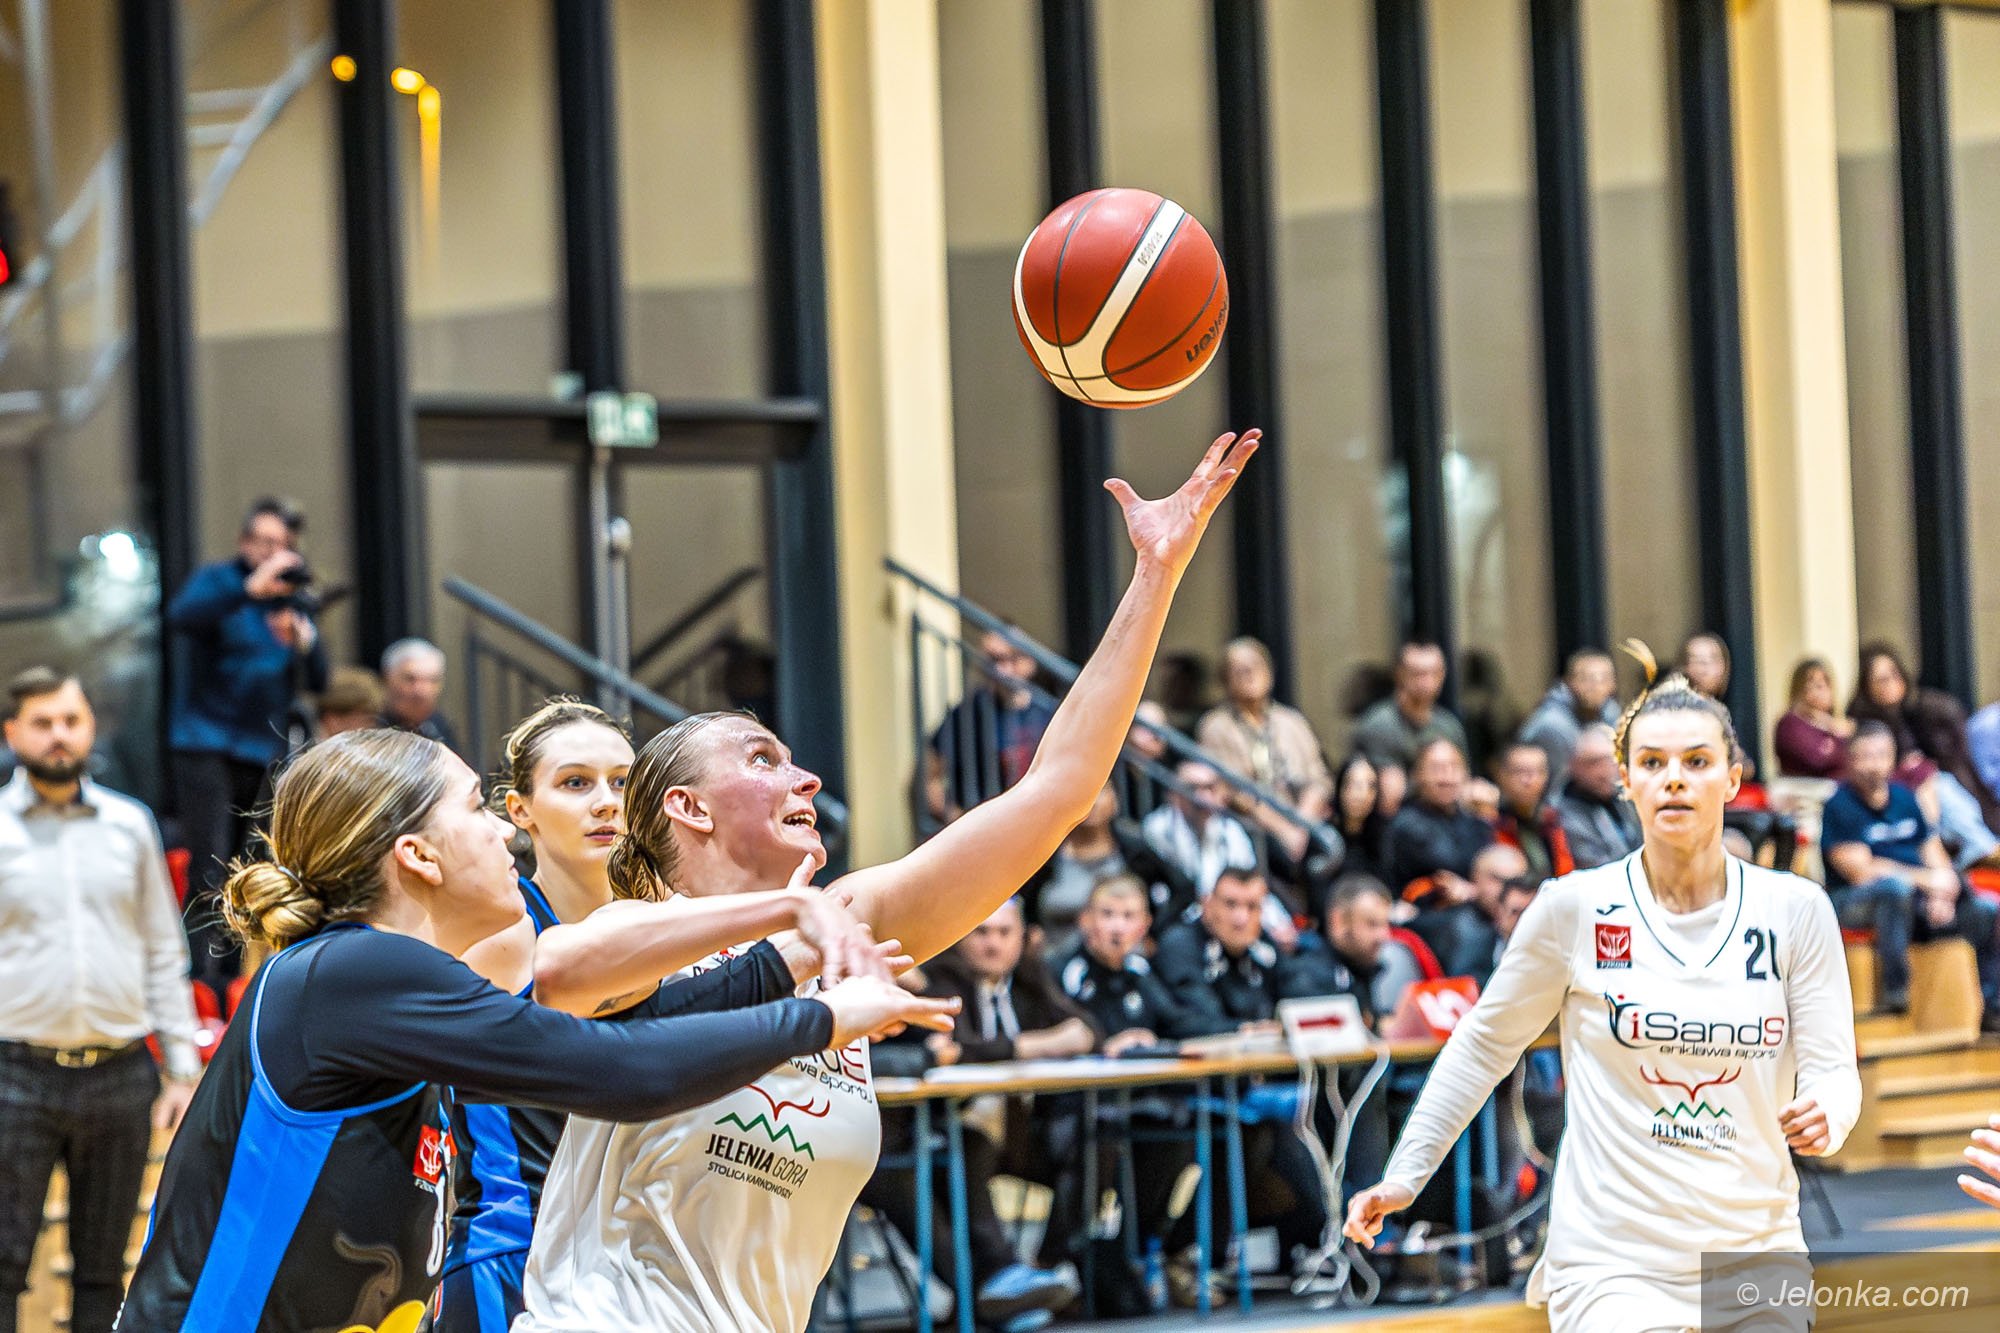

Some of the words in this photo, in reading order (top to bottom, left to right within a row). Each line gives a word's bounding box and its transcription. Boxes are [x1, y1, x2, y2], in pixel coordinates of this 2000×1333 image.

[1744, 926, 1781, 981] 21
[705, 1133, 775, 1173] JELENIA
[772, 1156, 809, 1188] GÓRA
[708, 1161, 745, 1182] STOLICA
